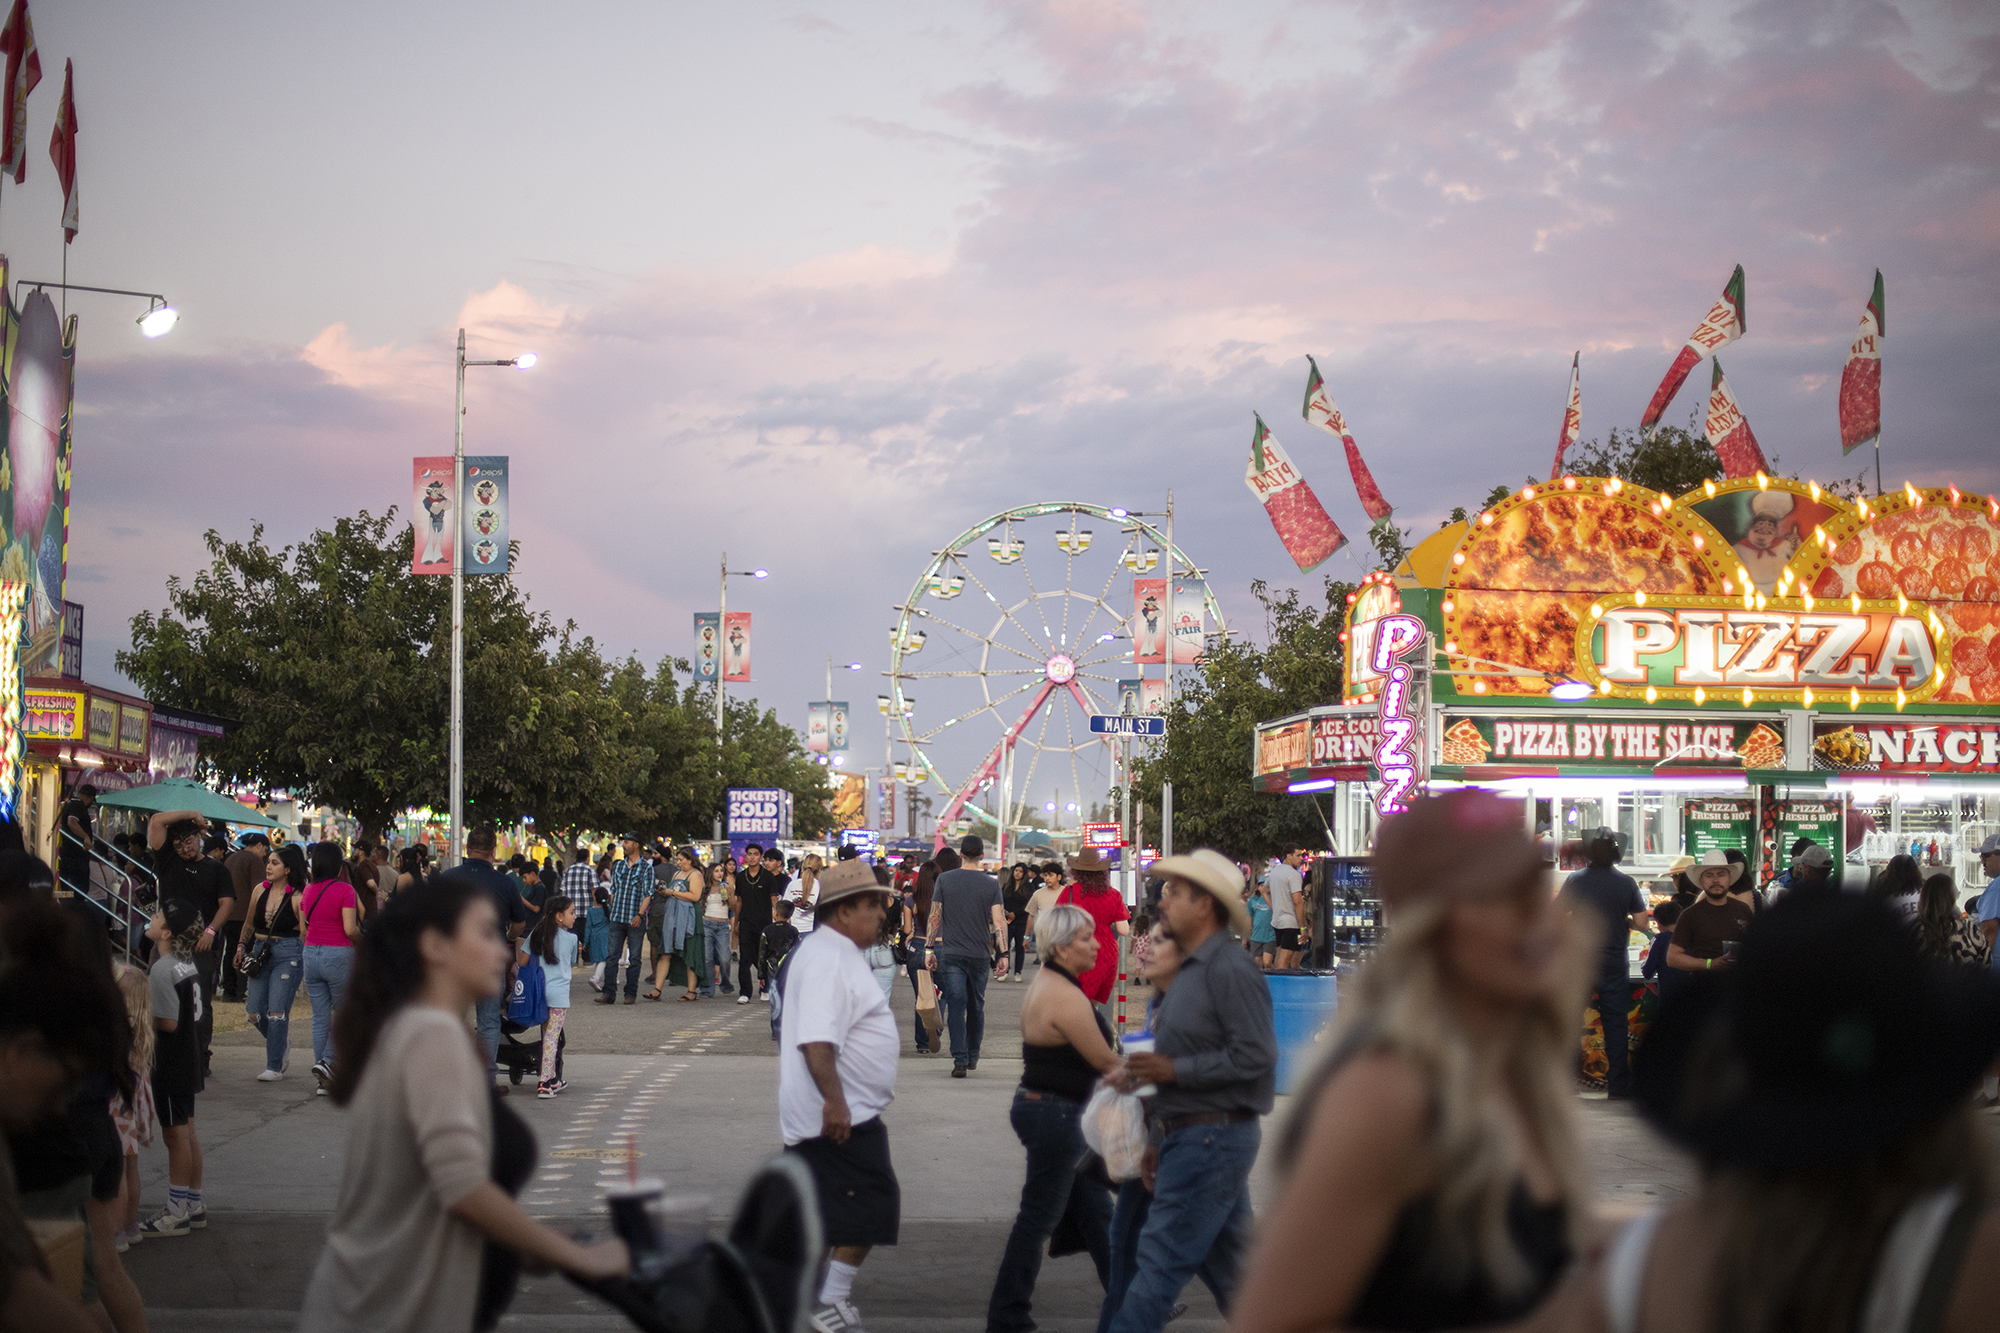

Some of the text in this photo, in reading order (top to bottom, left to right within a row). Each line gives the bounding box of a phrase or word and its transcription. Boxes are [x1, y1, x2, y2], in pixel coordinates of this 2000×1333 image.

[431, 468, 453, 476] pepsi
[481, 468, 503, 476] pepsi
[1174, 626, 1202, 636] FAIR
[1599, 608, 1936, 687] PIZZA
[25, 695, 76, 711] EFRESHING
[21, 711, 75, 736] INKS
[1104, 717, 1151, 734] MAIN ST
[1322, 720, 1342, 736] ICE
[1314, 735, 1382, 760] DRIN
[1495, 722, 1735, 761] PIZZA BY THE SLICE
[729, 790, 779, 802] TICKETS
[729, 802, 778, 818] SOLD
[1691, 810, 1752, 820] FRESH & HOT
[1704, 803, 1739, 812] PIZZA
[1792, 804, 1826, 813] PIZZA
[1779, 811, 1839, 821] FRESH & HOT
[729, 818, 778, 833] HERE!
